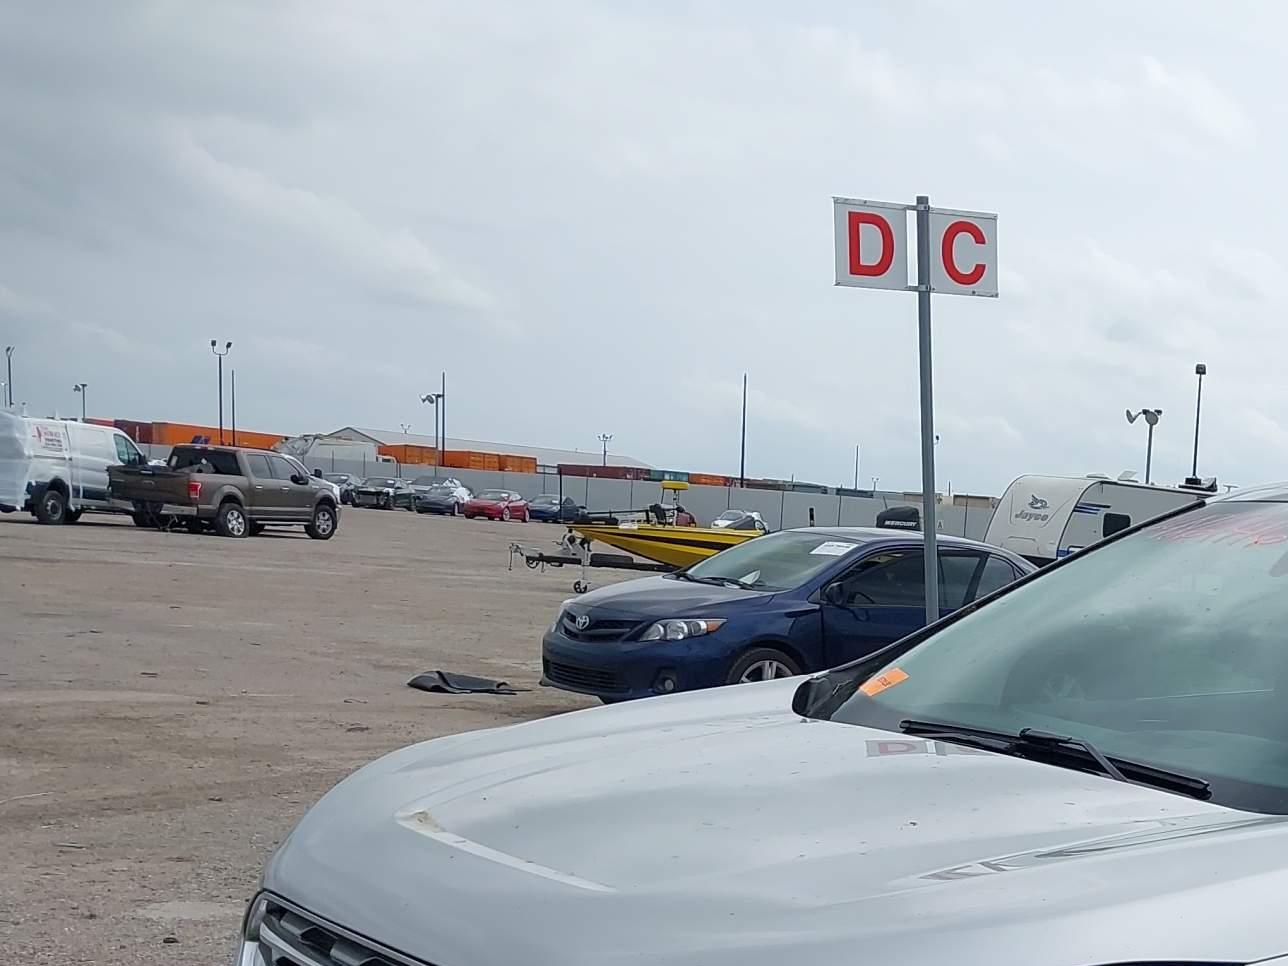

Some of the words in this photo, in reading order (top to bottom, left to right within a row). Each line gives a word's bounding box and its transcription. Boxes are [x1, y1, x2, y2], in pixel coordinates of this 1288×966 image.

[847, 210, 895, 278] D
[941, 220, 987, 287] C
[884, 520, 917, 528] MERCURY
[1015, 510, 1049, 522] Jayco
